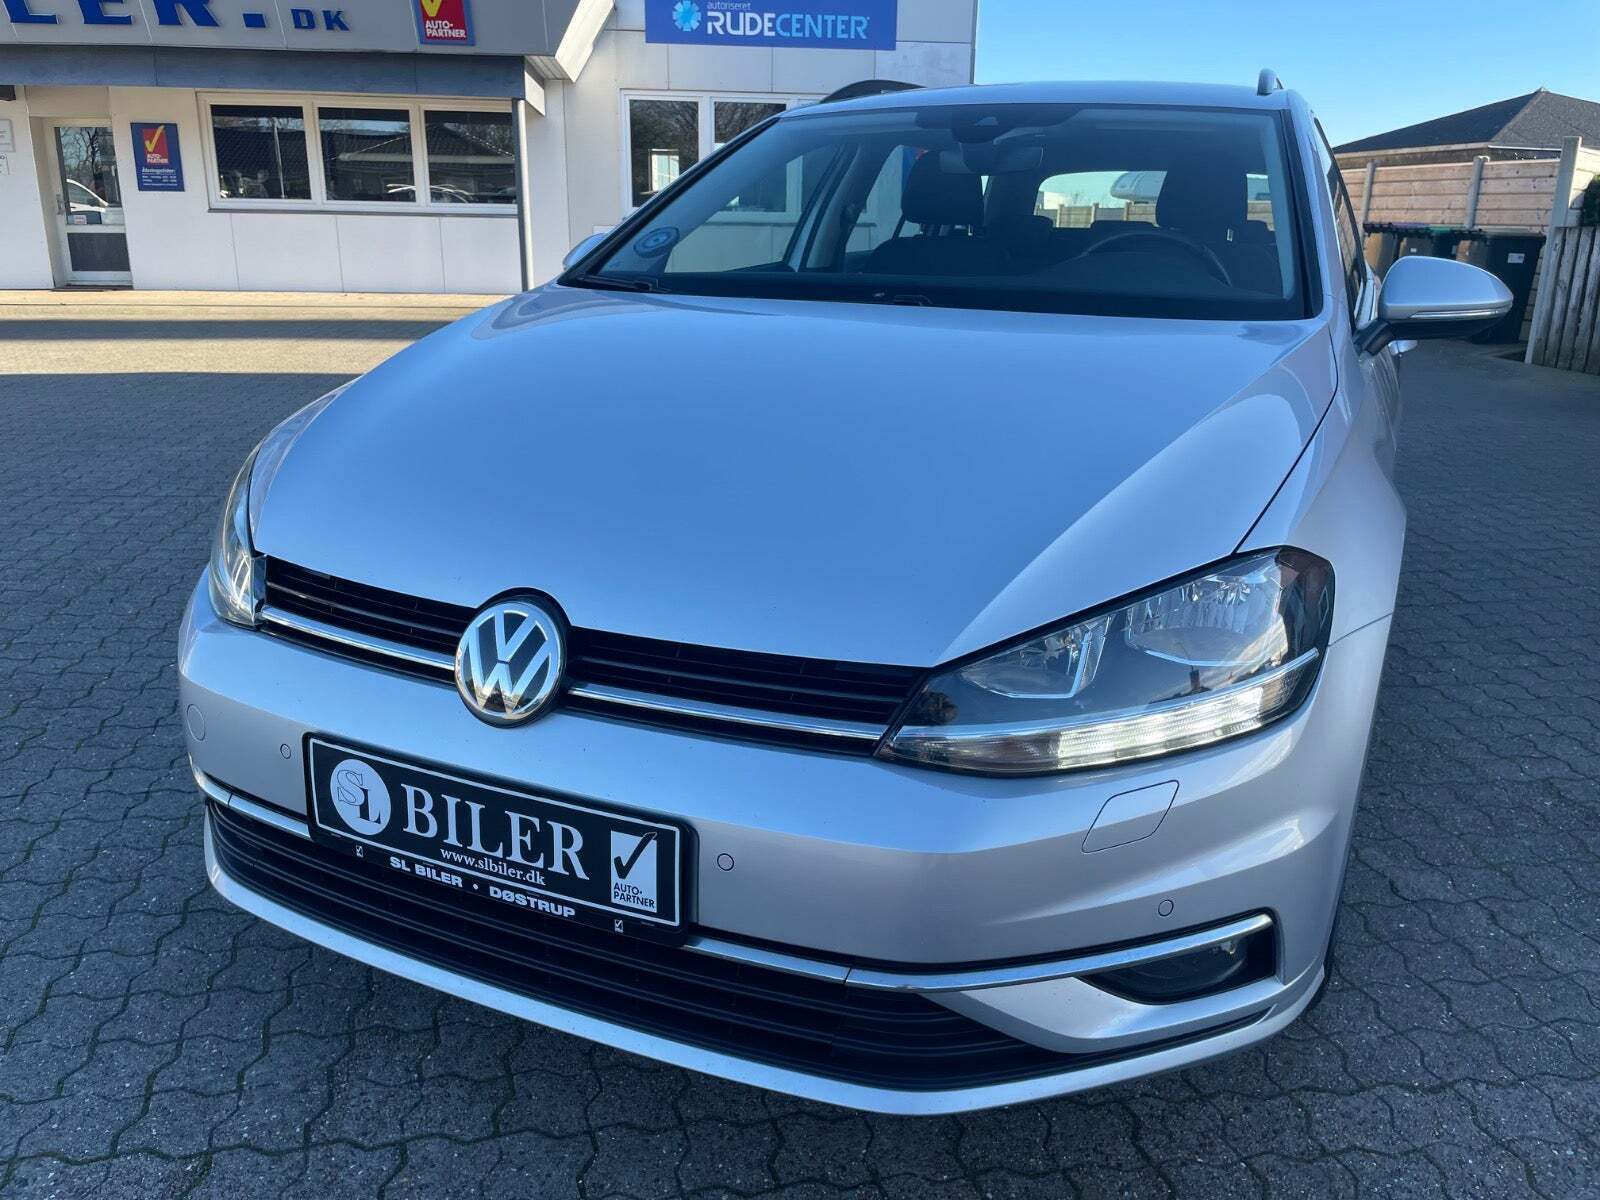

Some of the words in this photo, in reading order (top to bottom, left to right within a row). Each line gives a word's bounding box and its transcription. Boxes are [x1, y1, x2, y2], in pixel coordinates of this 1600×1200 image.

[425, 20, 453, 29] AUTO-
[426, 28, 466, 38] PARTNER
[707, 11, 870, 39] RUDECENTER
[400, 783, 590, 881] BILER
[440, 848, 547, 886] www.slbiler.dk
[389, 856, 411, 872] SL
[414, 863, 463, 888] BILER
[489, 885, 576, 918] DØSTRUP
[613, 890, 655, 909] PARTNER
